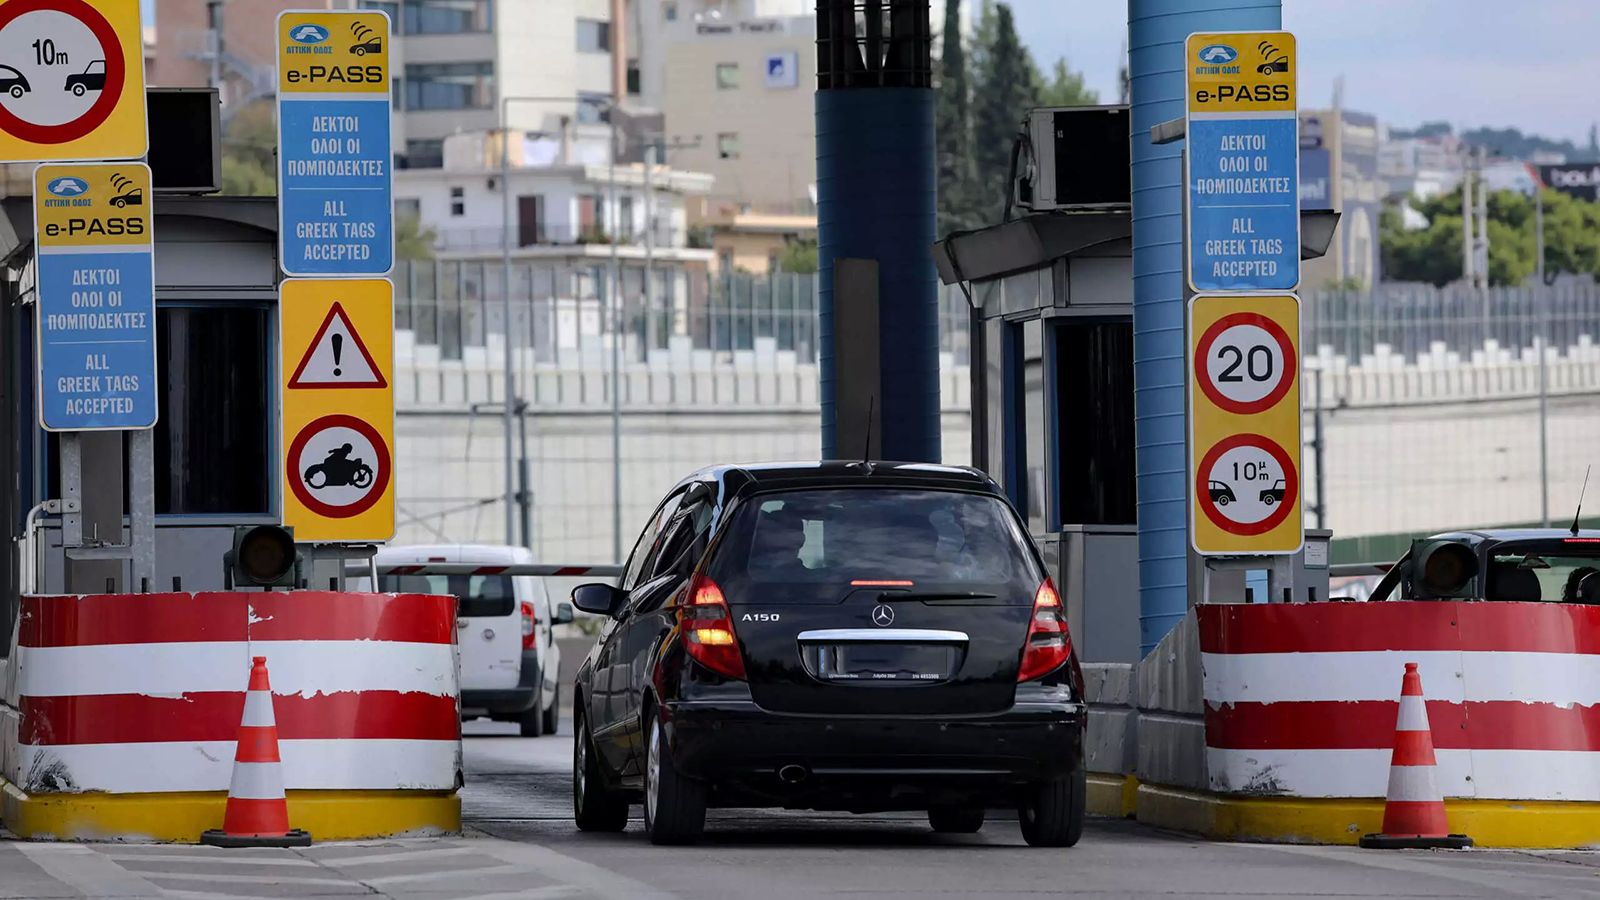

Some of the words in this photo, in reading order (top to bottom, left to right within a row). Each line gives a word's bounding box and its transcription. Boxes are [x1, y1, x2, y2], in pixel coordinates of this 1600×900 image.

[32, 38, 68, 66] 10m
[287, 65, 383, 83] e-PASS
[1196, 84, 1290, 103] e-PASS
[312, 116, 359, 132] ΔΕΚΤΟΙ
[310, 138, 342, 154] ΟΛΟΙ
[346, 138, 360, 154] ΟΙ
[1220, 134, 1266, 151] ΔΕΚΤΟΙ
[288, 160, 384, 176] ΠΟΜΠΟΔΕΚΤΕΣ
[1220, 156, 1250, 173] ΟΛΟΙ
[1254, 156, 1268, 172] ΟΙ
[1197, 177, 1290, 195] ΠΟΜΠΟΔΕΚΤΕΣ
[323, 200, 348, 217] ALL
[45, 217, 144, 236] e-PASS
[296, 222, 338, 239] GREEK
[342, 222, 376, 239] TAGS
[1232, 218, 1255, 234] ALL
[304, 244, 370, 261] ACCEPTED
[1205, 239, 1247, 256] GREEK
[1250, 238, 1283, 255] TAGS
[72, 268, 120, 286] ΔΕΚΤΟΙ
[1213, 260, 1277, 277] ACCEPTED
[71, 291, 103, 308] ΟΛΟΙ
[108, 290, 122, 307] ΟΙ
[48, 312, 147, 331] ΠΟΜΠΟΔΕΚΤΕΣ
[85, 354, 110, 371] ALL
[1217, 344, 1273, 382] 20
[57, 376, 101, 393] GREEK
[105, 375, 140, 392] TAGS
[66, 397, 134, 415] ACCEPTED
[741, 613, 780, 622] A150
